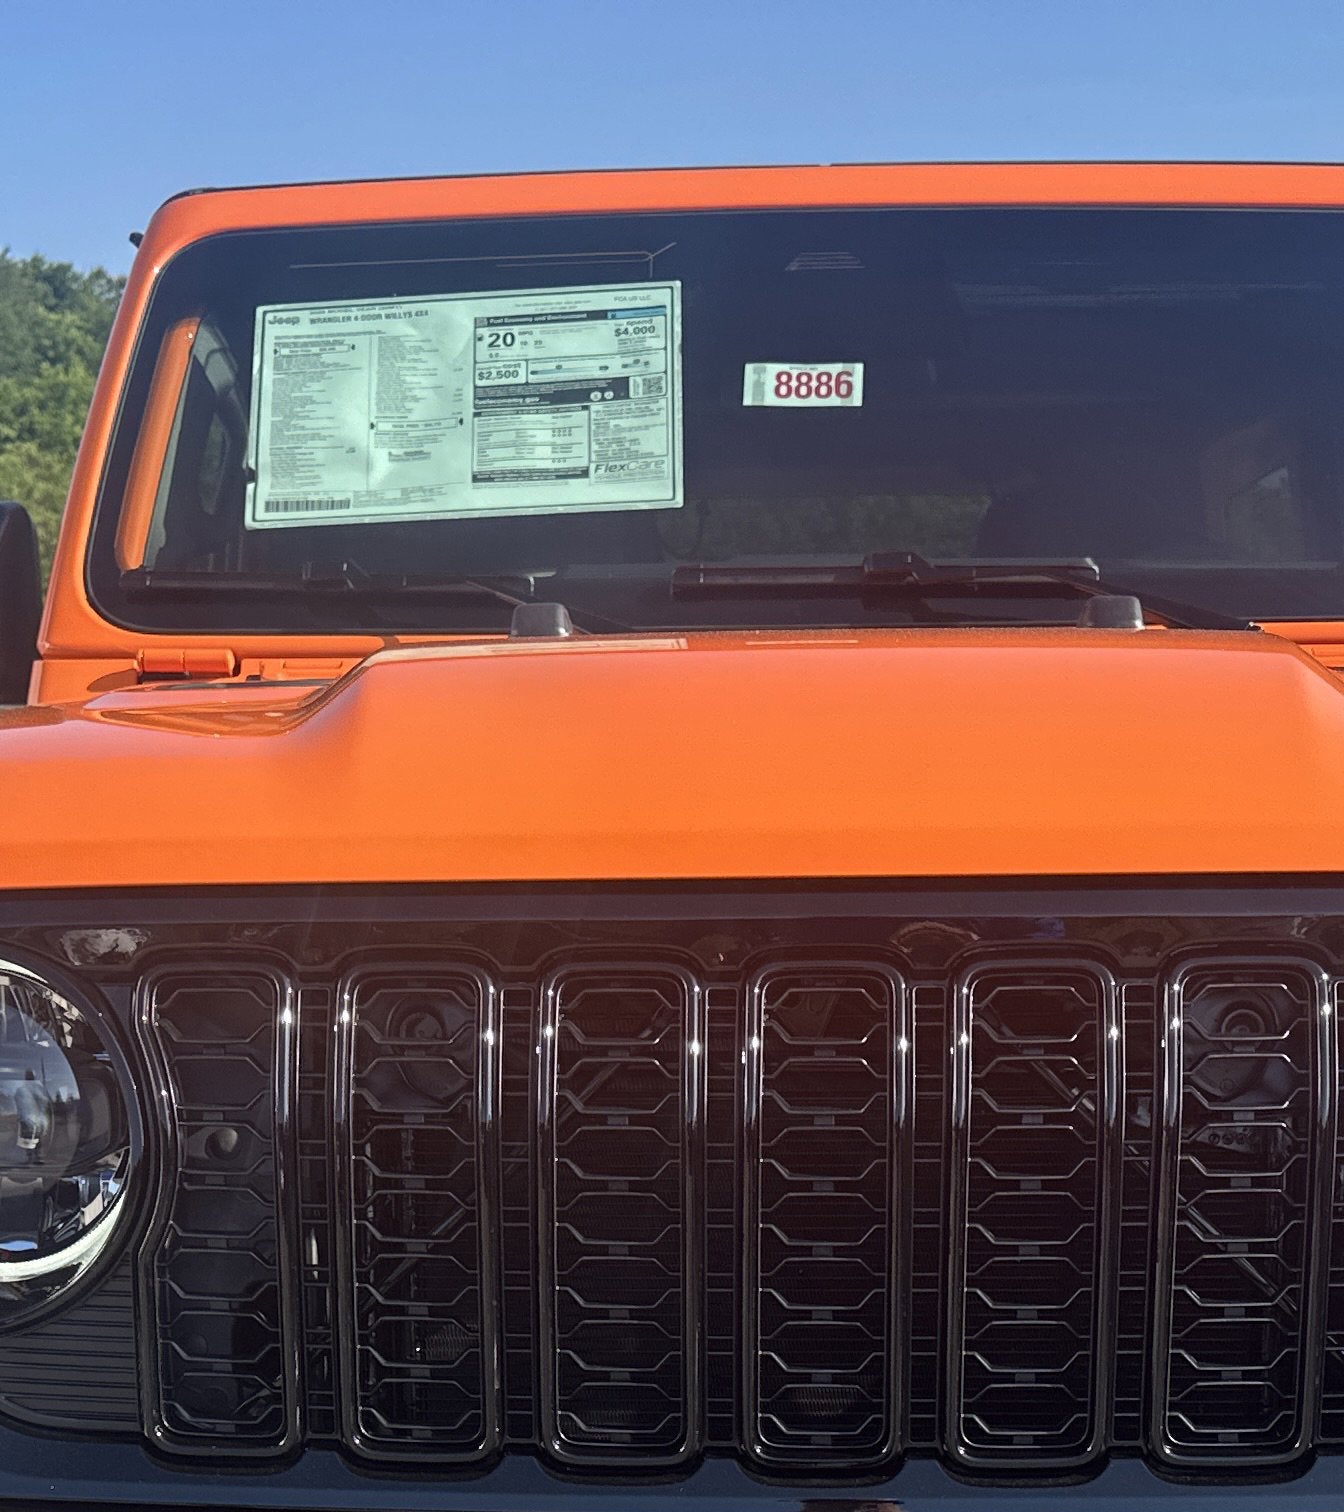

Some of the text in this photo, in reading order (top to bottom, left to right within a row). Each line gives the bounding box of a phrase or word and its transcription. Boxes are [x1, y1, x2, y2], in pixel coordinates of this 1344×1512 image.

[268, 315, 301, 326] Jeep
[309, 315, 352, 325] WRANGLER
[614, 325, 656, 337] $4,000
[487, 332, 516, 348] 20
[477, 370, 519, 381] $2,500
[774, 371, 853, 399] 8886
[594, 459, 665, 474] FlexCare
